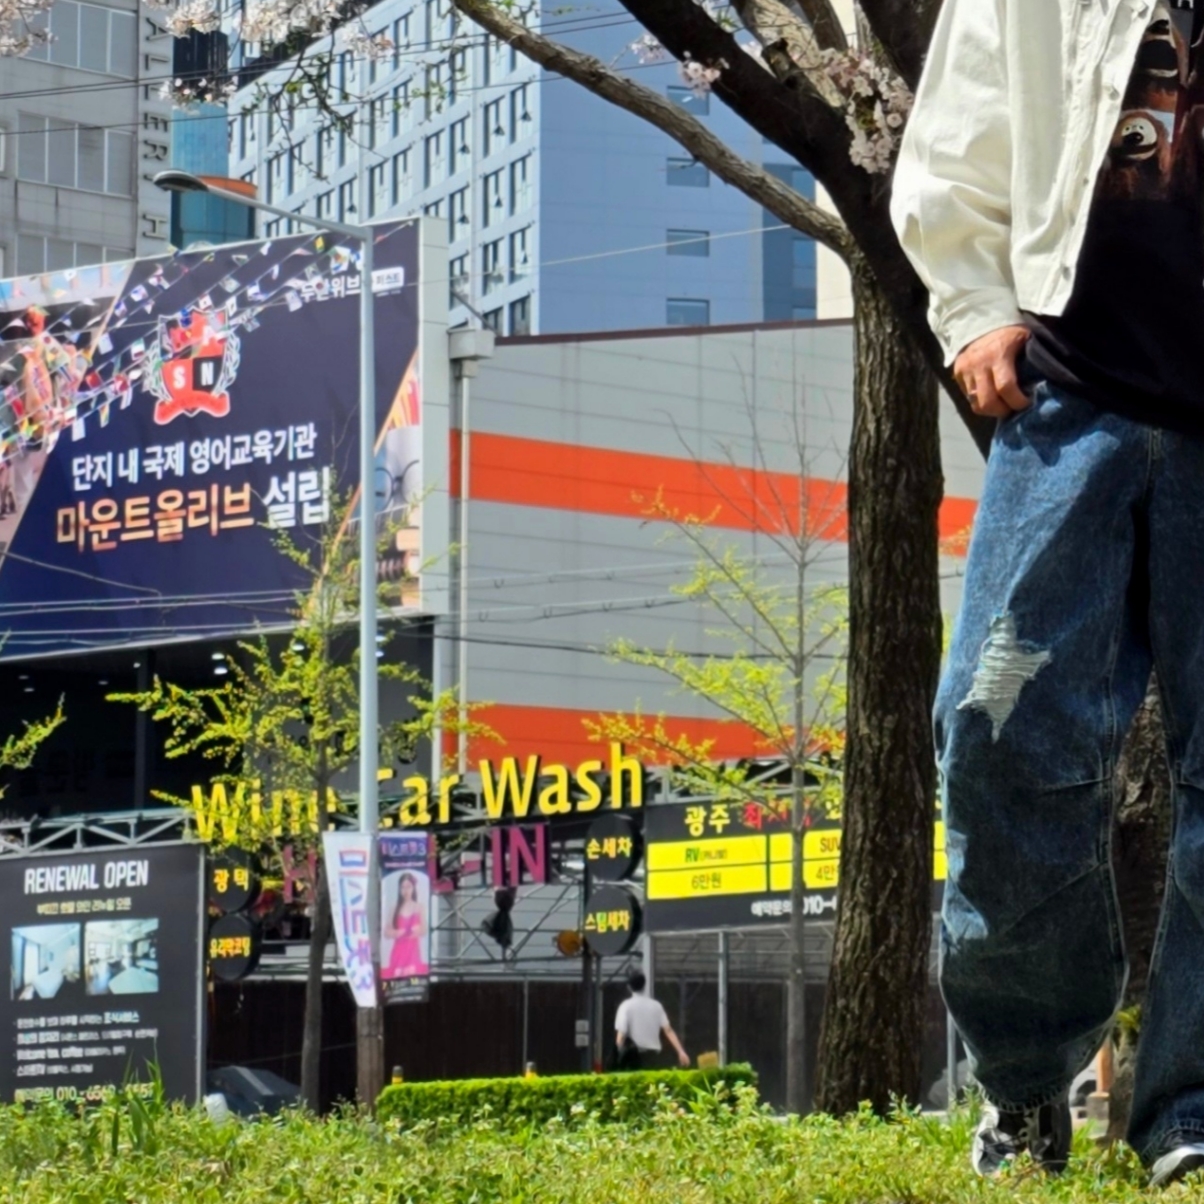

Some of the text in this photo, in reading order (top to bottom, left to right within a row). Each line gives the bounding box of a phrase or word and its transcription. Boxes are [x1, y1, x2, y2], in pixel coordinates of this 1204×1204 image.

[72, 424, 318, 491] 단지 내 국제 영어교육기관
[56, 468, 330, 553] 마운트올리브 설립
[479, 741, 644, 820] Wash
[684, 803, 731, 837] 광주
[586, 837, 633, 859] 손세차
[24, 859, 149, 895] RENEWAL OPEN
[213, 868, 249, 893] 광택
[691, 872, 722, 890] 6만원
[816, 865, 841, 882] 4만
[584, 910, 631, 933] 스팀세차
